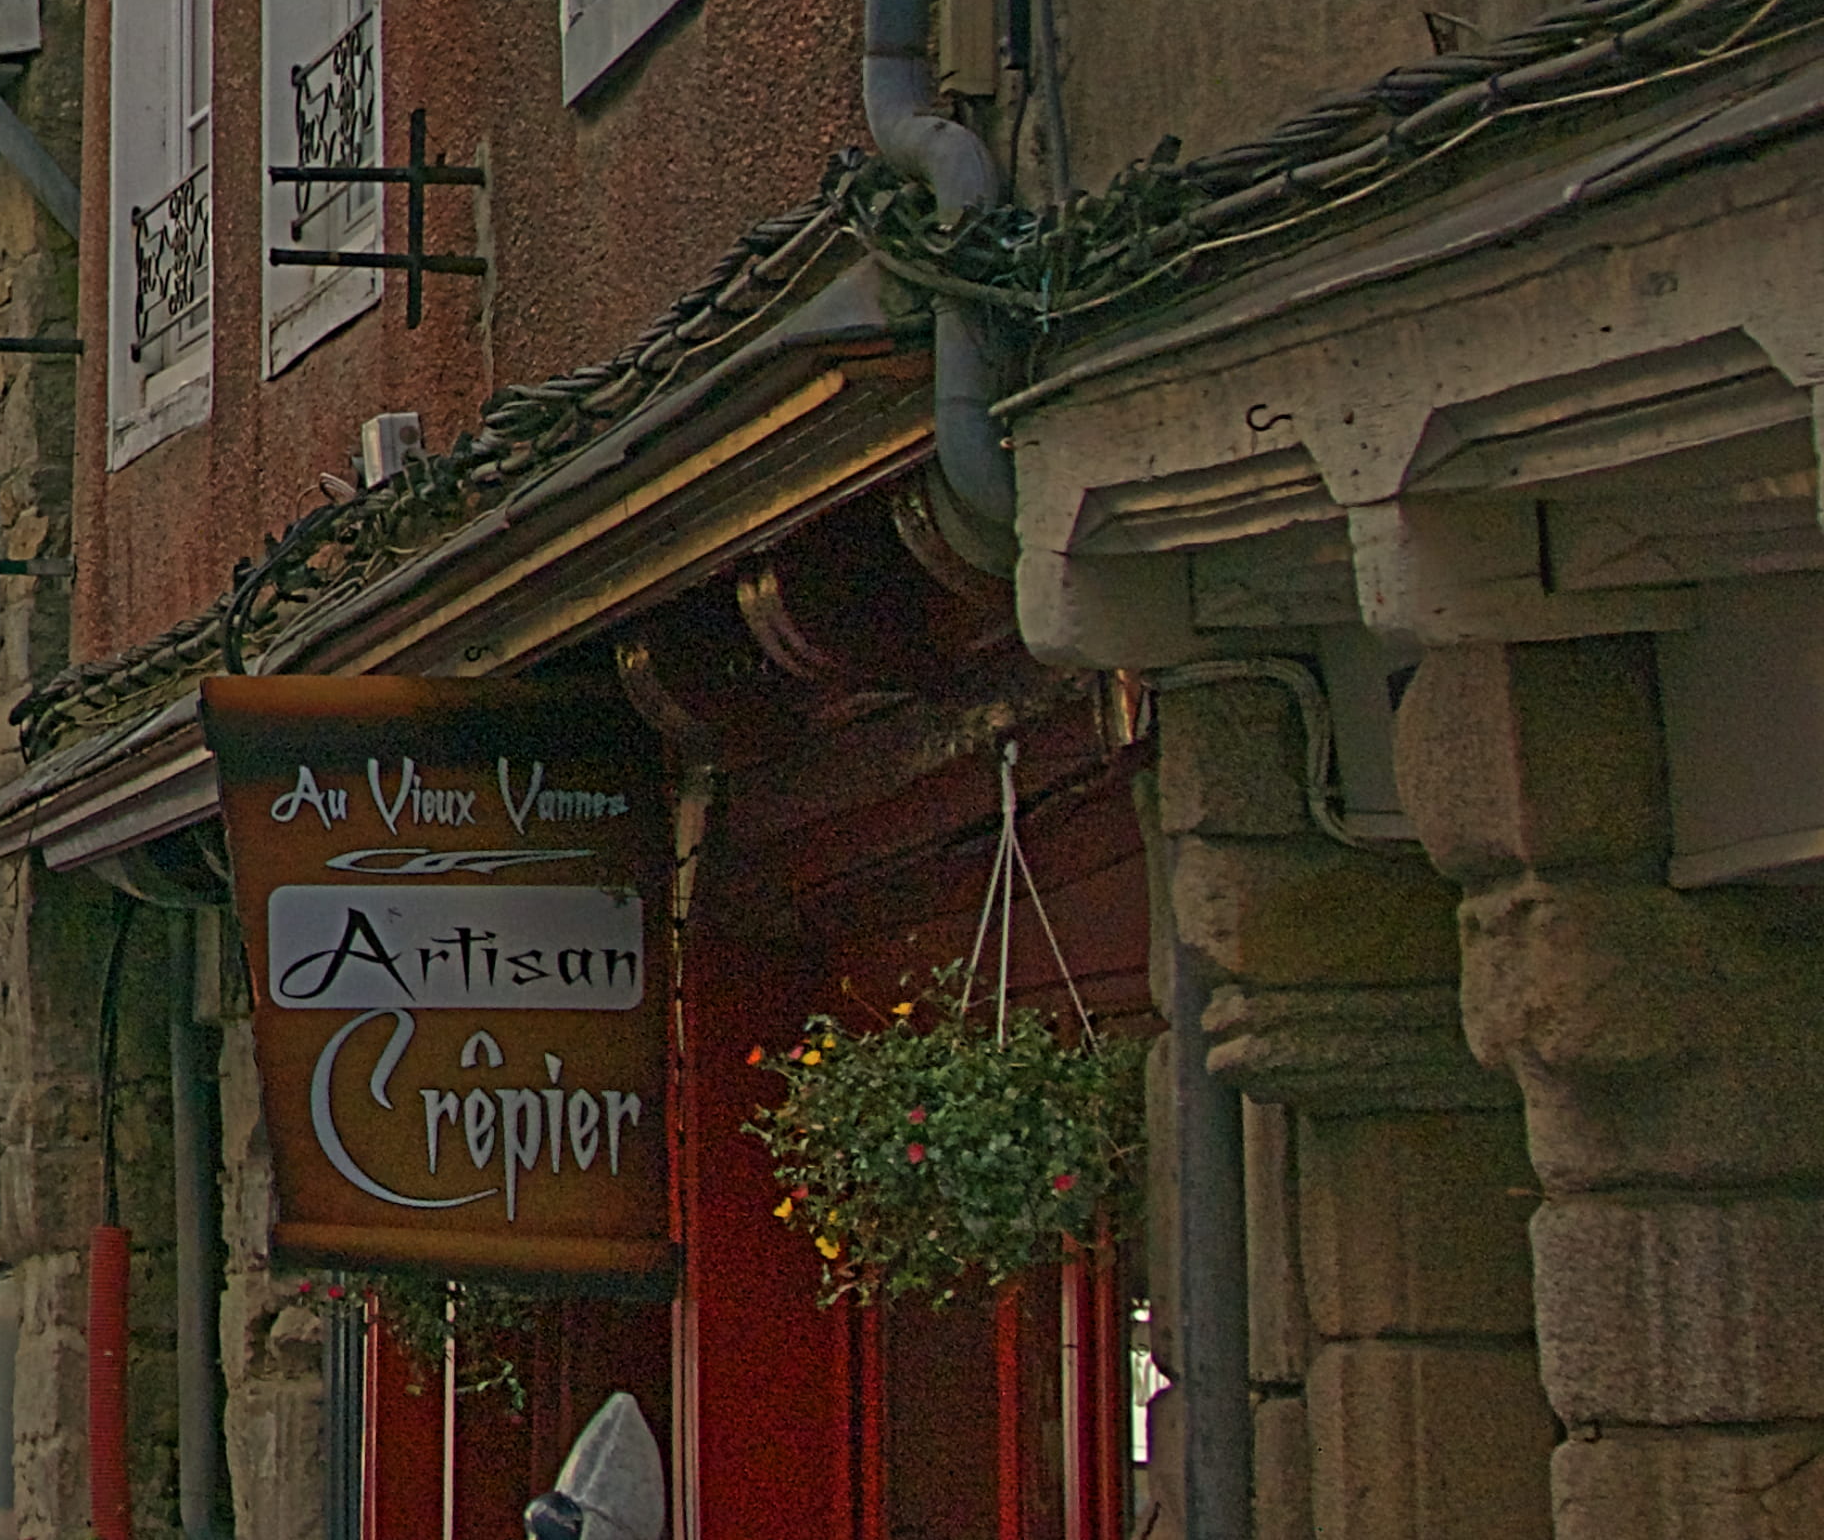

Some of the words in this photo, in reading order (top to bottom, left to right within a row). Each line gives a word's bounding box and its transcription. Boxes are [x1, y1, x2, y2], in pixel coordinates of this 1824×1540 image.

[270, 764, 348, 832] Au
[367, 757, 477, 836] Vieux
[497, 756, 630, 836] Vannes
[279, 907, 638, 1001] Artisan
[310, 1007, 643, 1223] Crêpier
